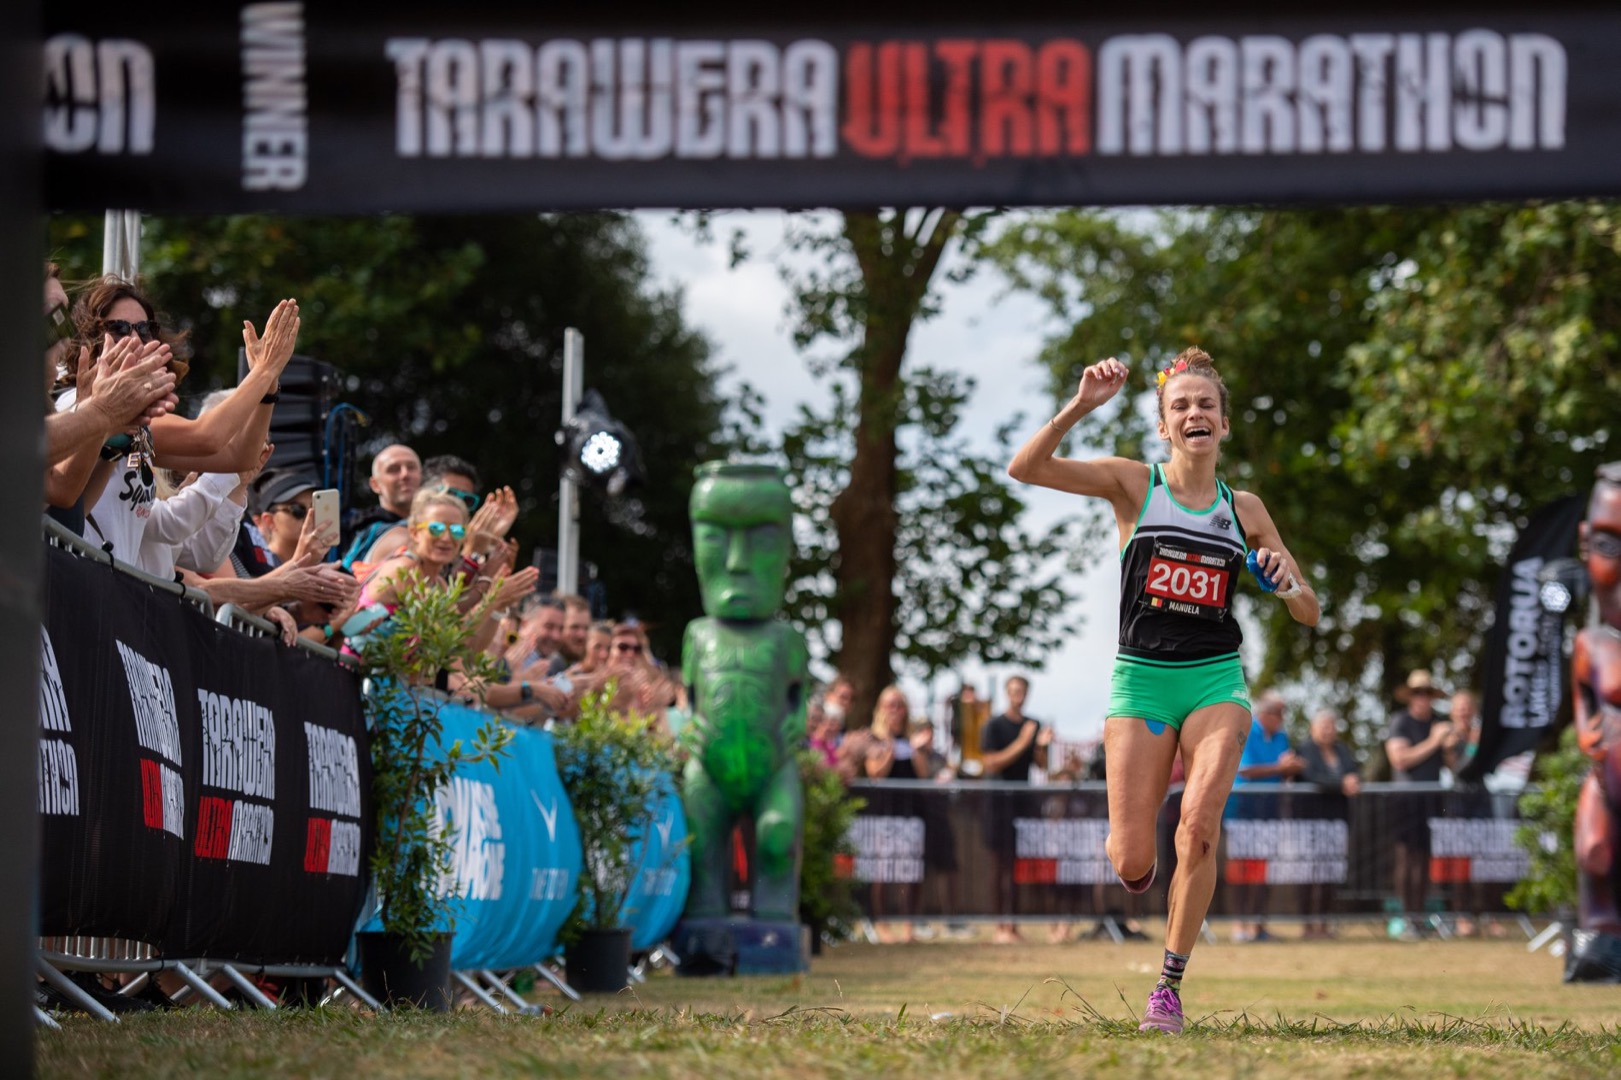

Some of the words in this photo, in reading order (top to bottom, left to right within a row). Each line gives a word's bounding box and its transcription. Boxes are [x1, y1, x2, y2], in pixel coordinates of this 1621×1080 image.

[240, 1, 308, 191] WINNER
[386, 37, 838, 159] TARAWERA
[842, 39, 1091, 158] ULTRA
[1097, 30, 1568, 155] MARATHON
[1150, 563, 1221, 602] 2031
[1168, 601, 1200, 615] MANUELA
[1501, 556, 1543, 728] ROTORUA
[198, 688, 275, 800] TARAWERA
